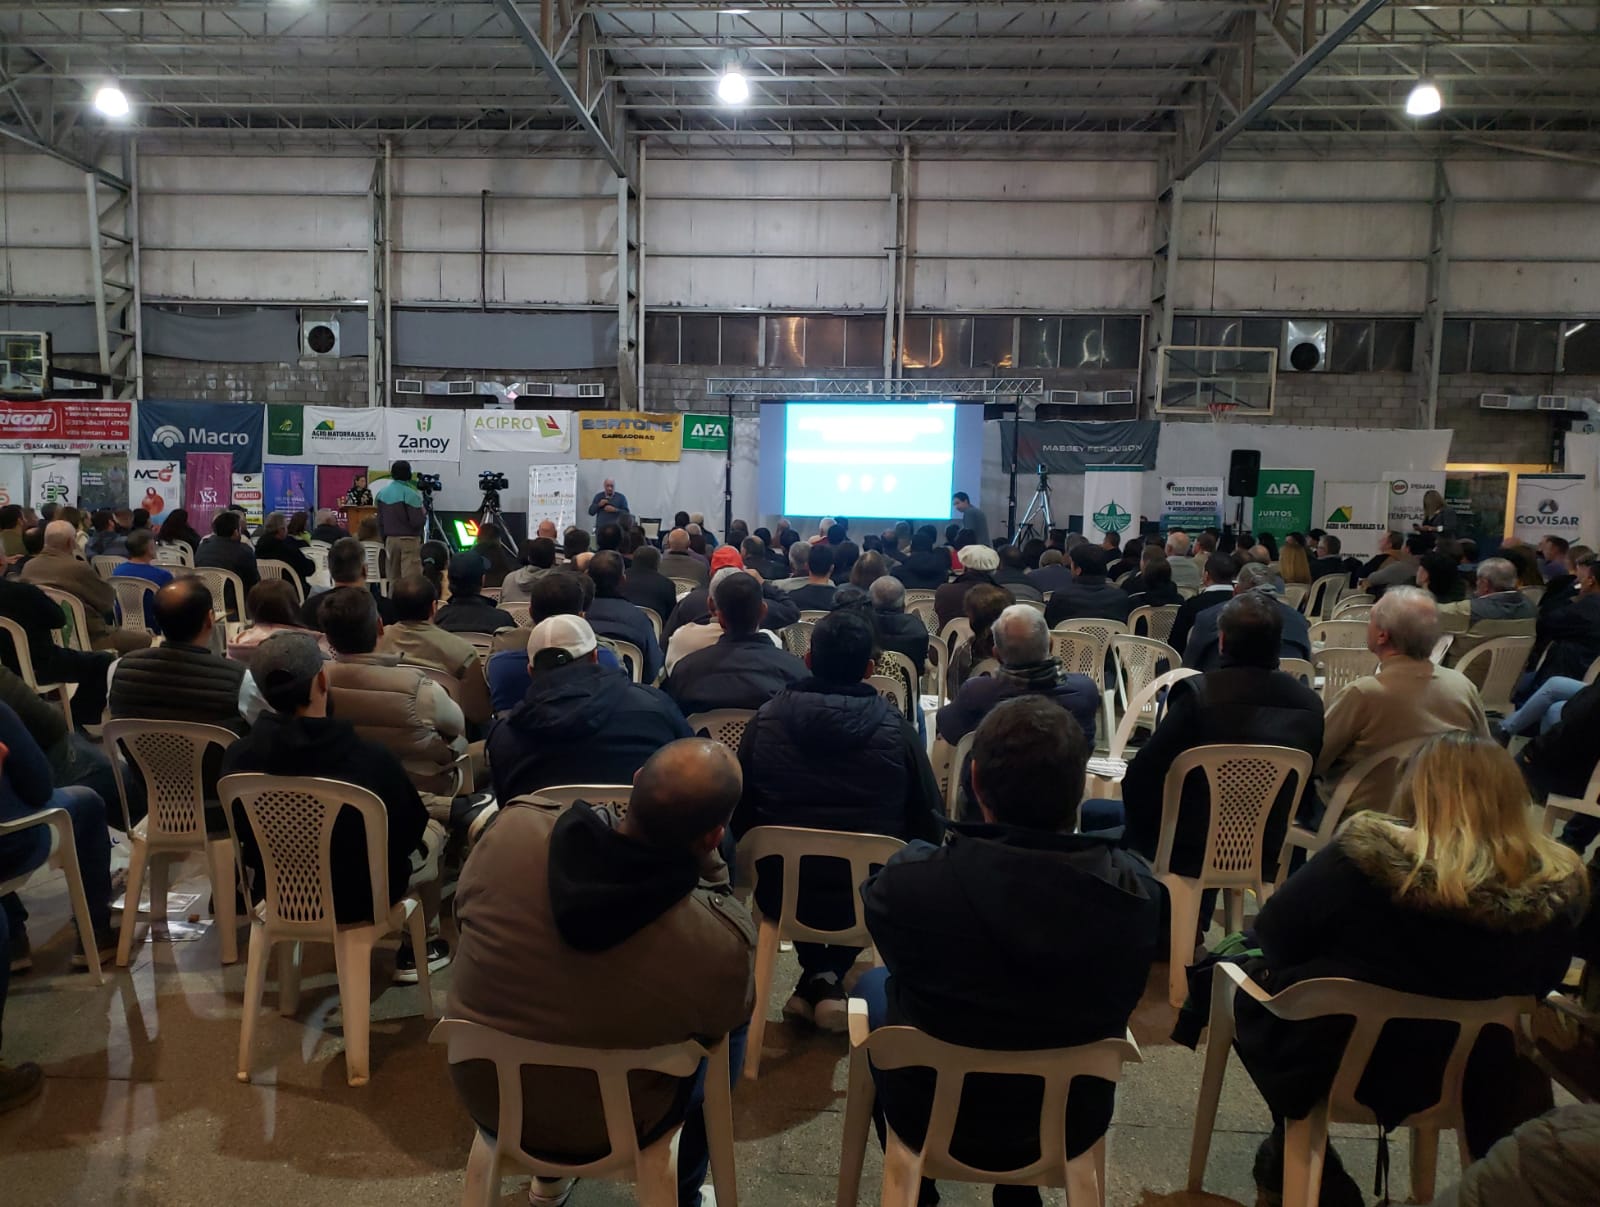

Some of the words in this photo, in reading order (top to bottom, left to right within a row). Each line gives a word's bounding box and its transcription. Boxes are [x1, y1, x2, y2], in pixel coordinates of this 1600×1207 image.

[474, 416, 534, 430] ACIPRO
[582, 418, 673, 432] BERTONE
[691, 424, 726, 436] AFA
[188, 428, 249, 446] Macro
[398, 434, 450, 453] Zanoy
[1042, 444, 1084, 452] MASSEY
[1087, 444, 1142, 453] FERGUSON
[134, 467, 174, 482] MCG
[1266, 484, 1300, 494] AFA
[1517, 516, 1579, 526] COVISAR
